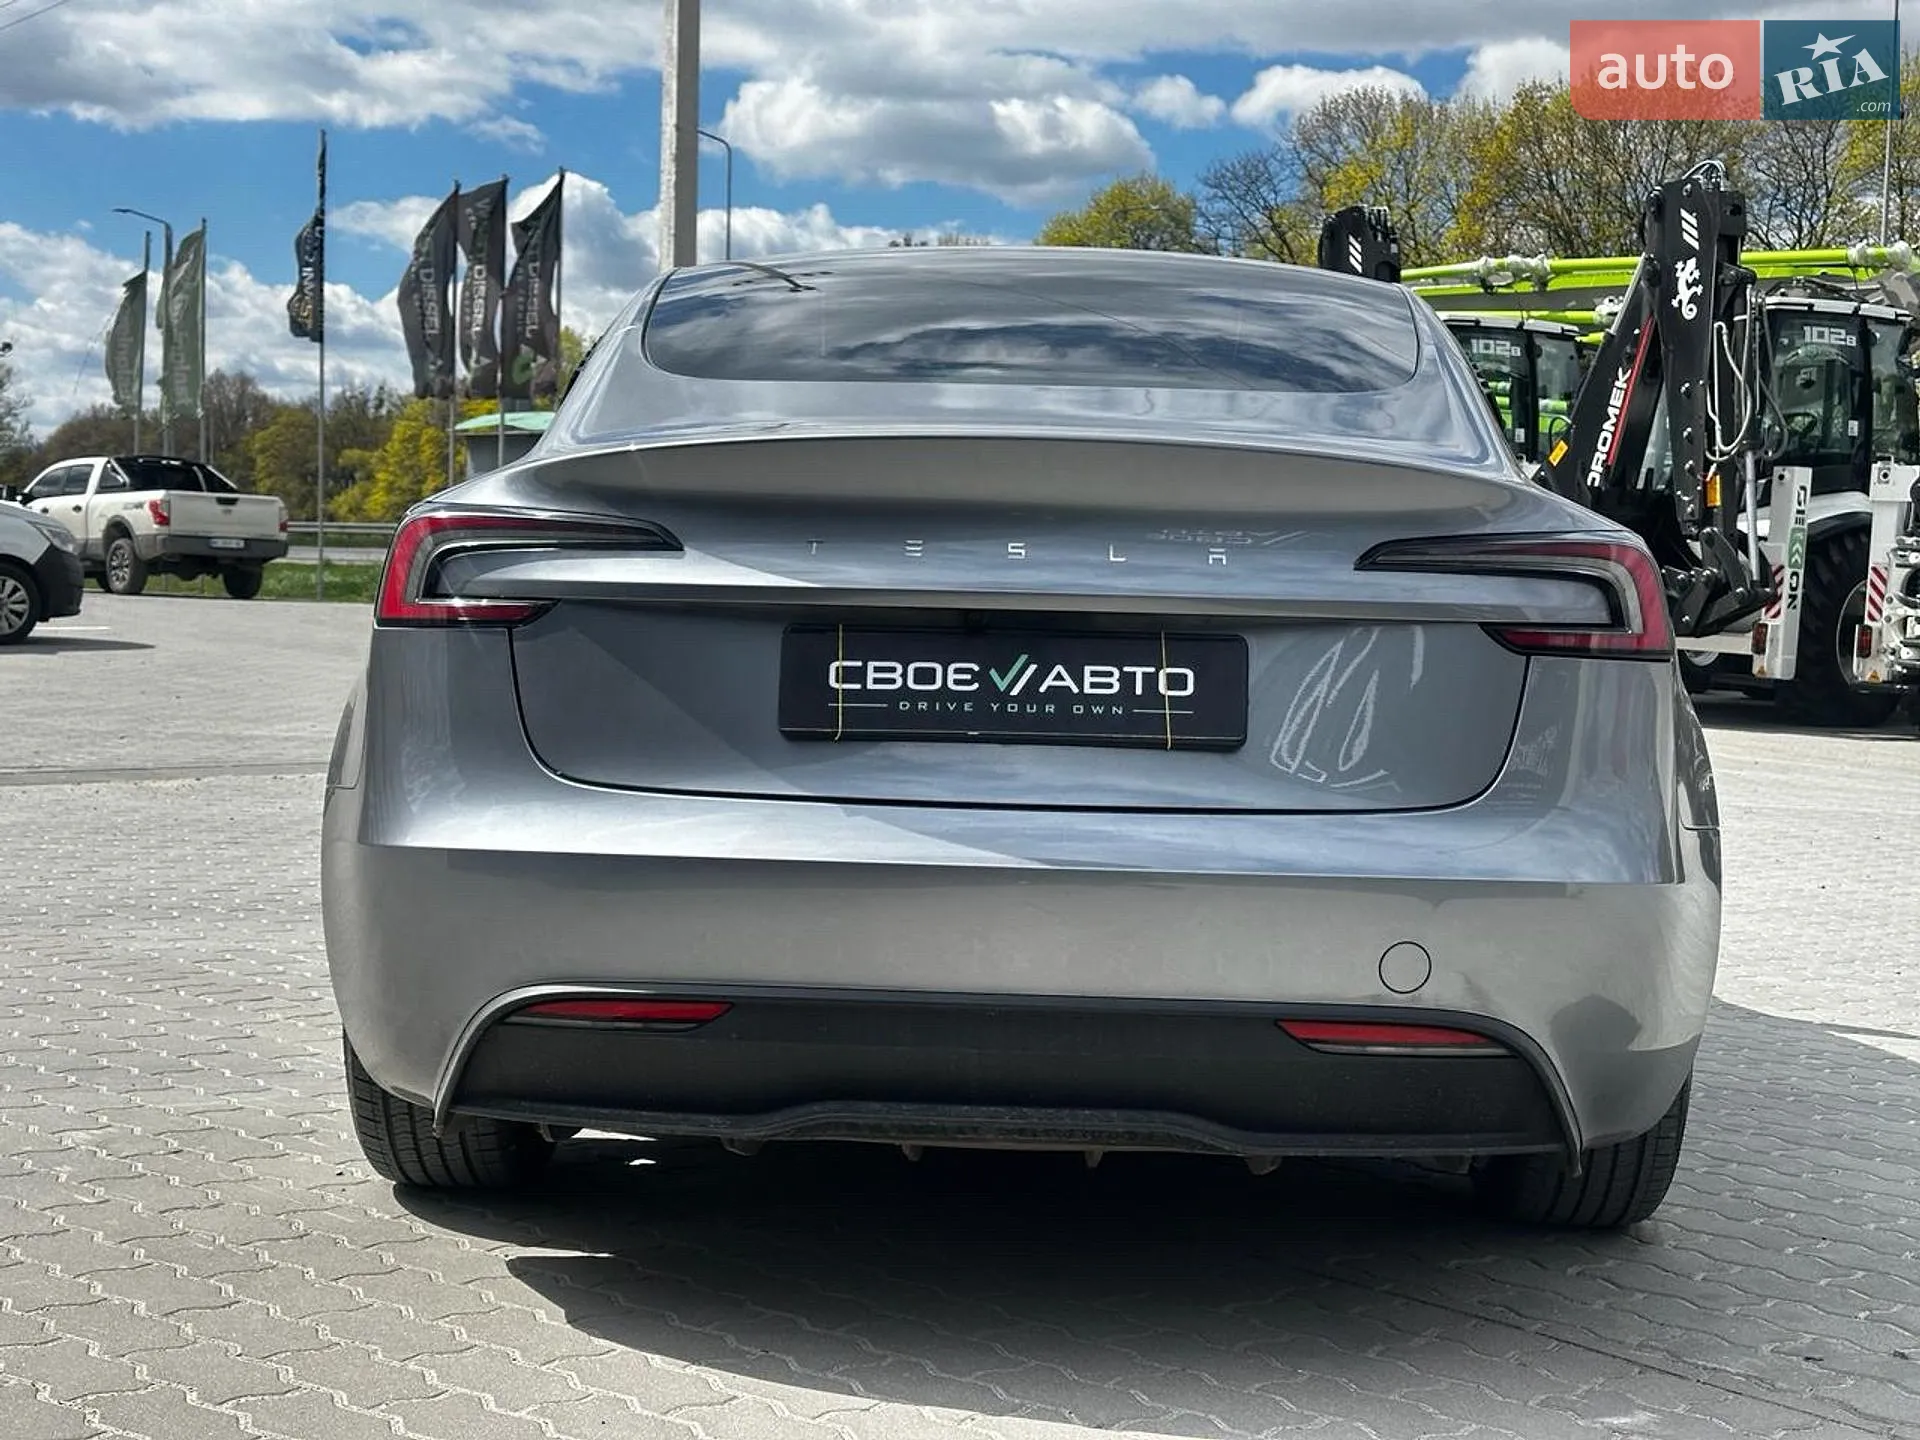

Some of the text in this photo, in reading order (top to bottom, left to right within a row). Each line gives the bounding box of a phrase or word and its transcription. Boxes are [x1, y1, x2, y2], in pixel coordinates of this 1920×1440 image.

[419, 267, 442, 337] DIESEL
[806, 539, 1227, 566] TESLA
[1038, 663, 1196, 697] АВТО
[900, 702, 1125, 716] DRIVE YOUR OWN
